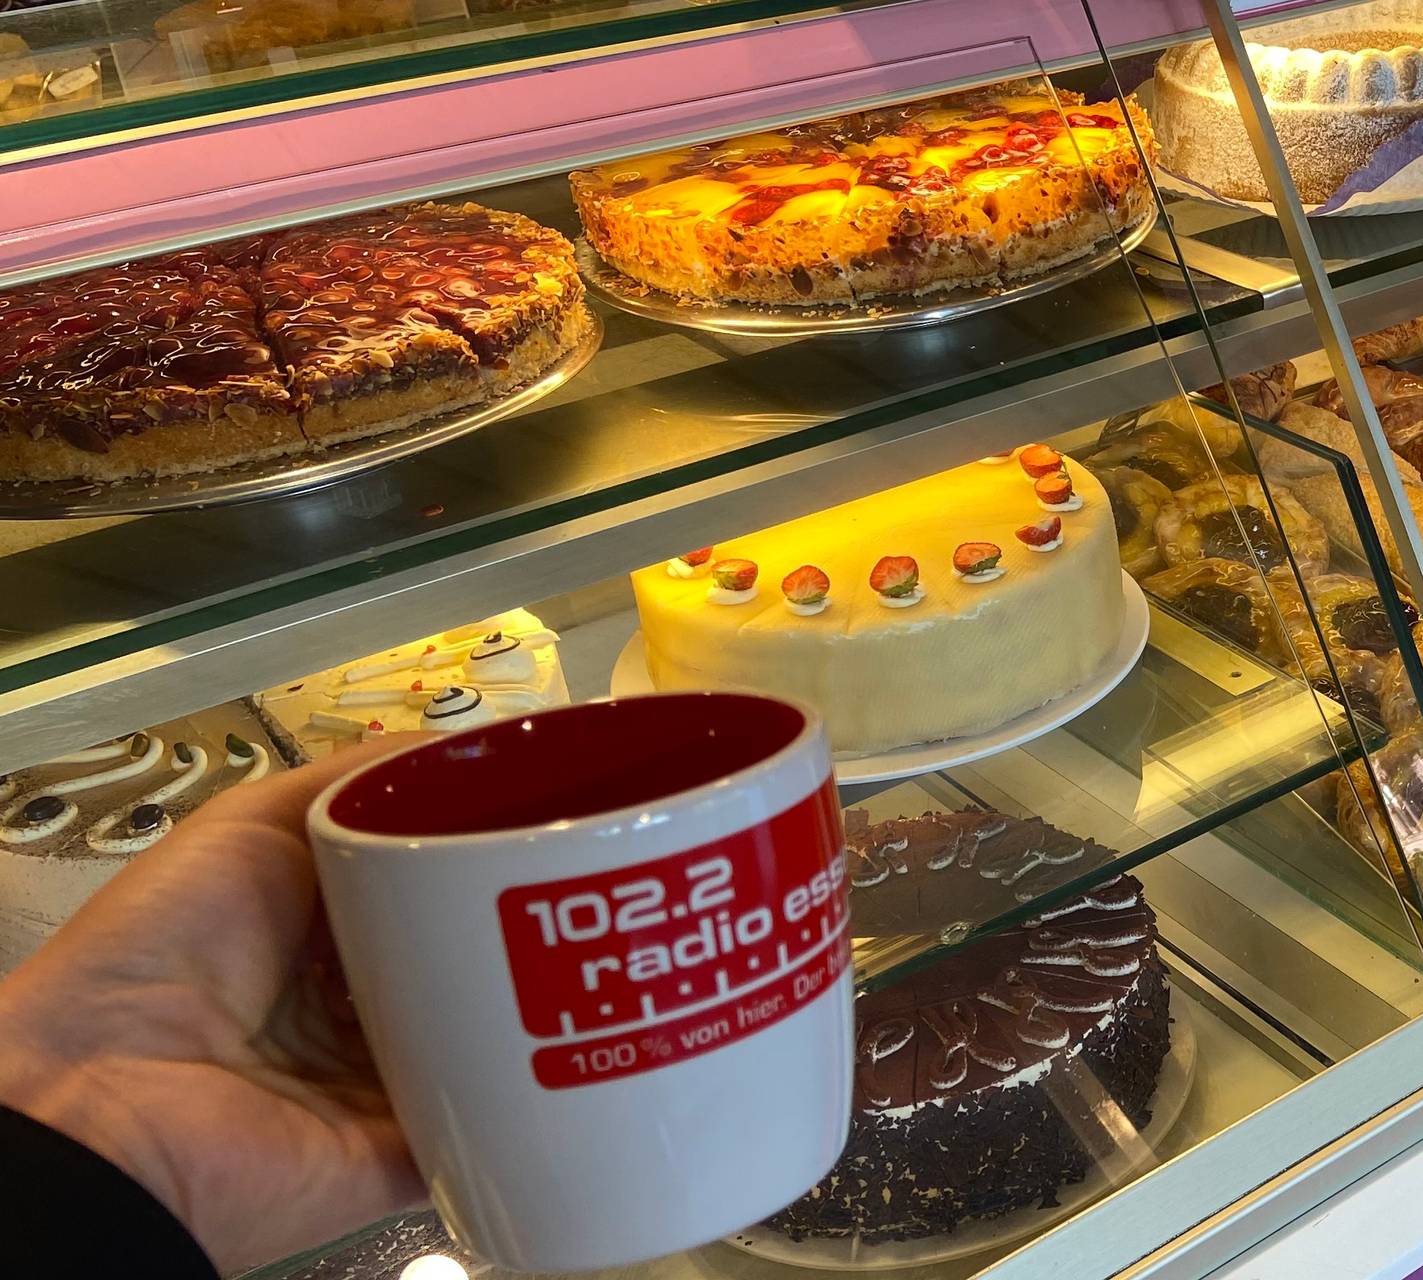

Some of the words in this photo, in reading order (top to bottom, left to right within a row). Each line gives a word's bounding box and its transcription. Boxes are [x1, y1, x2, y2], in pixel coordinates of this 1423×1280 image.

[526, 856, 736, 948] 102.2
[580, 903, 773, 991] radio
[571, 1042, 637, 1074] 100
[679, 1018, 729, 1050] von
